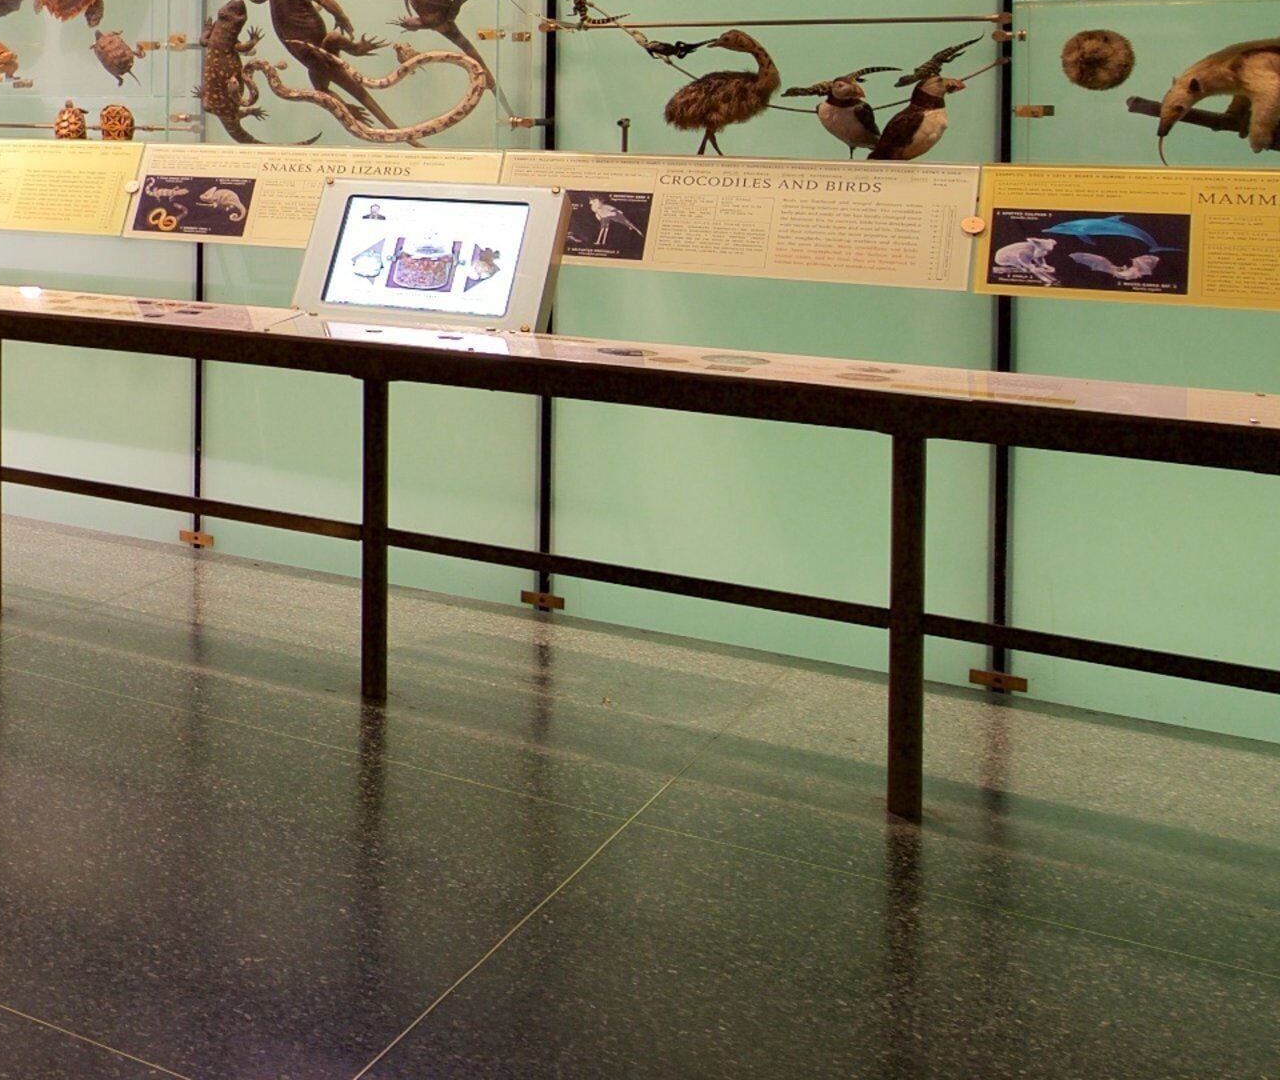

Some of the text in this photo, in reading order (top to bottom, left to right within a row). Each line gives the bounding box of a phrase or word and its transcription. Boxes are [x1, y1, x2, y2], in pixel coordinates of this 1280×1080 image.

[262, 161, 312, 174] SNAKES
[316, 163, 346, 175] AND
[351, 165, 412, 177] LIZARDS
[659, 174, 772, 189] CROCODILES
[778, 178, 818, 191] AND
[825, 180, 882, 193] BIRDS
[1197, 192, 1278, 207] MAMM
